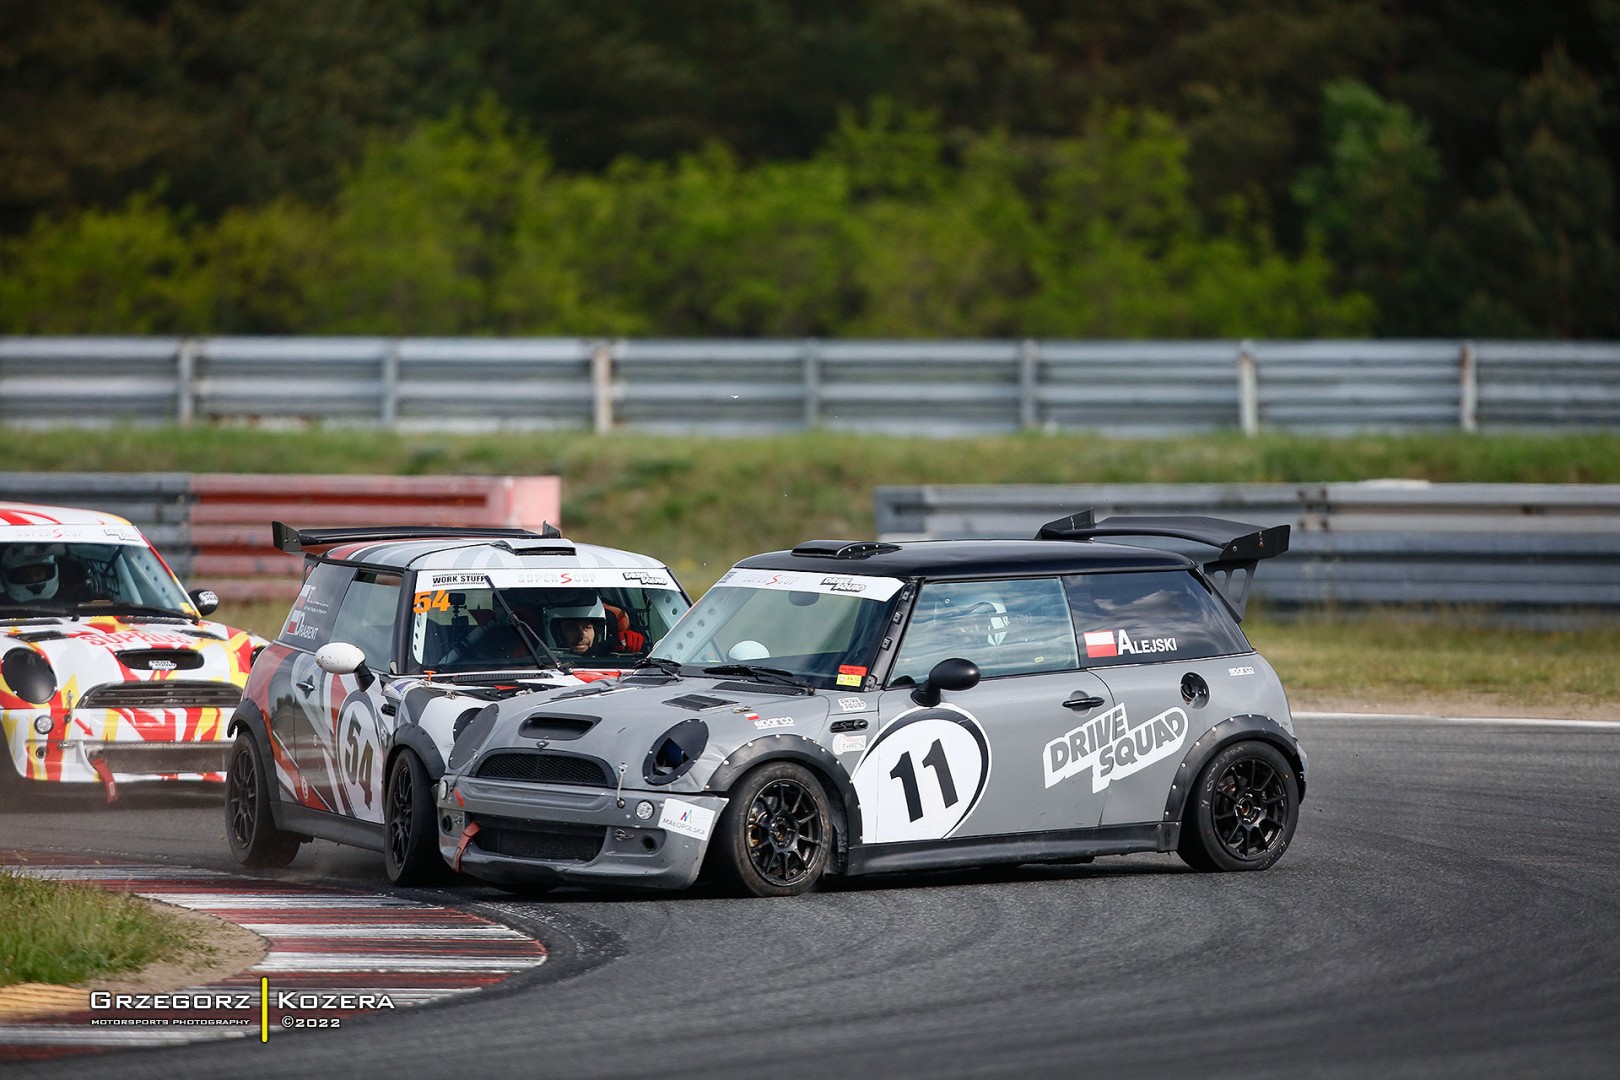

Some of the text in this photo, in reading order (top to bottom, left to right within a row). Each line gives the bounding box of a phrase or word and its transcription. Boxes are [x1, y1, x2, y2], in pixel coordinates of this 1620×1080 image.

[432, 575, 485, 584] WORK STUFF
[832, 583, 866, 592] SQUAD
[413, 589, 451, 614] 54
[294, 611, 319, 641] DRABENT
[1117, 629, 1177, 656] ALEJSKI
[754, 717, 795, 729] sparco
[1049, 707, 1127, 773] DRIVE
[1099, 710, 1185, 778] SQUAD
[345, 710, 374, 811] 54
[889, 738, 959, 823] 11
